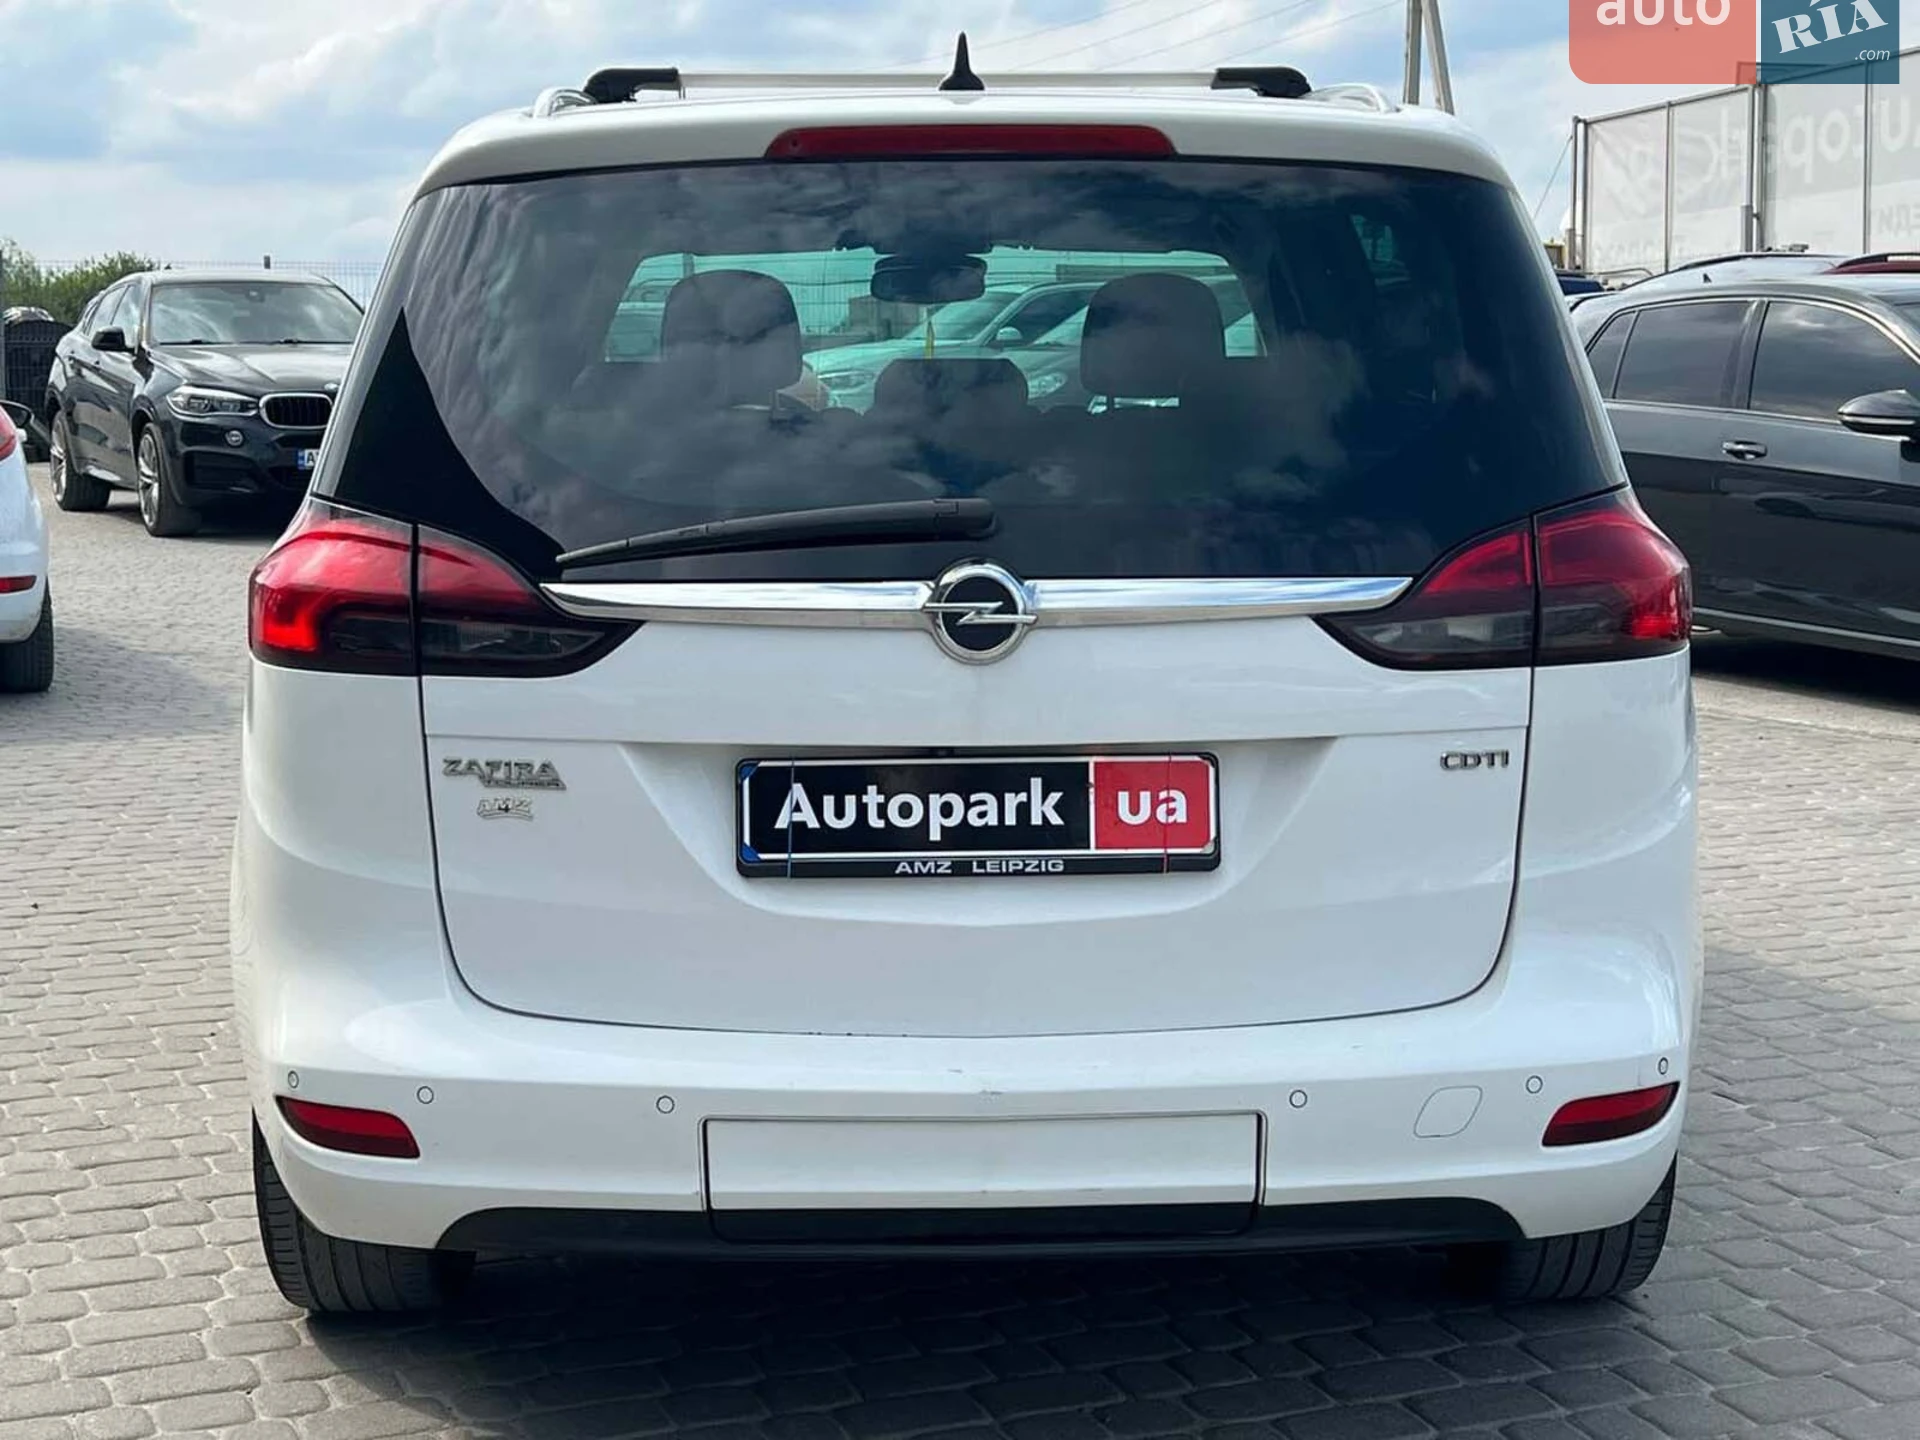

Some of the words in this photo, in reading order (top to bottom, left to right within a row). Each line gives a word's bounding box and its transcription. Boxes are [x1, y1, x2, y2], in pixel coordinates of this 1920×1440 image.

[1440, 750, 1509, 770] CDTI
[774, 778, 1065, 841] Autopark
[1117, 788, 1189, 825] ua
[894, 860, 953, 875] AMZ
[971, 858, 1065, 874] LEIPZIG
